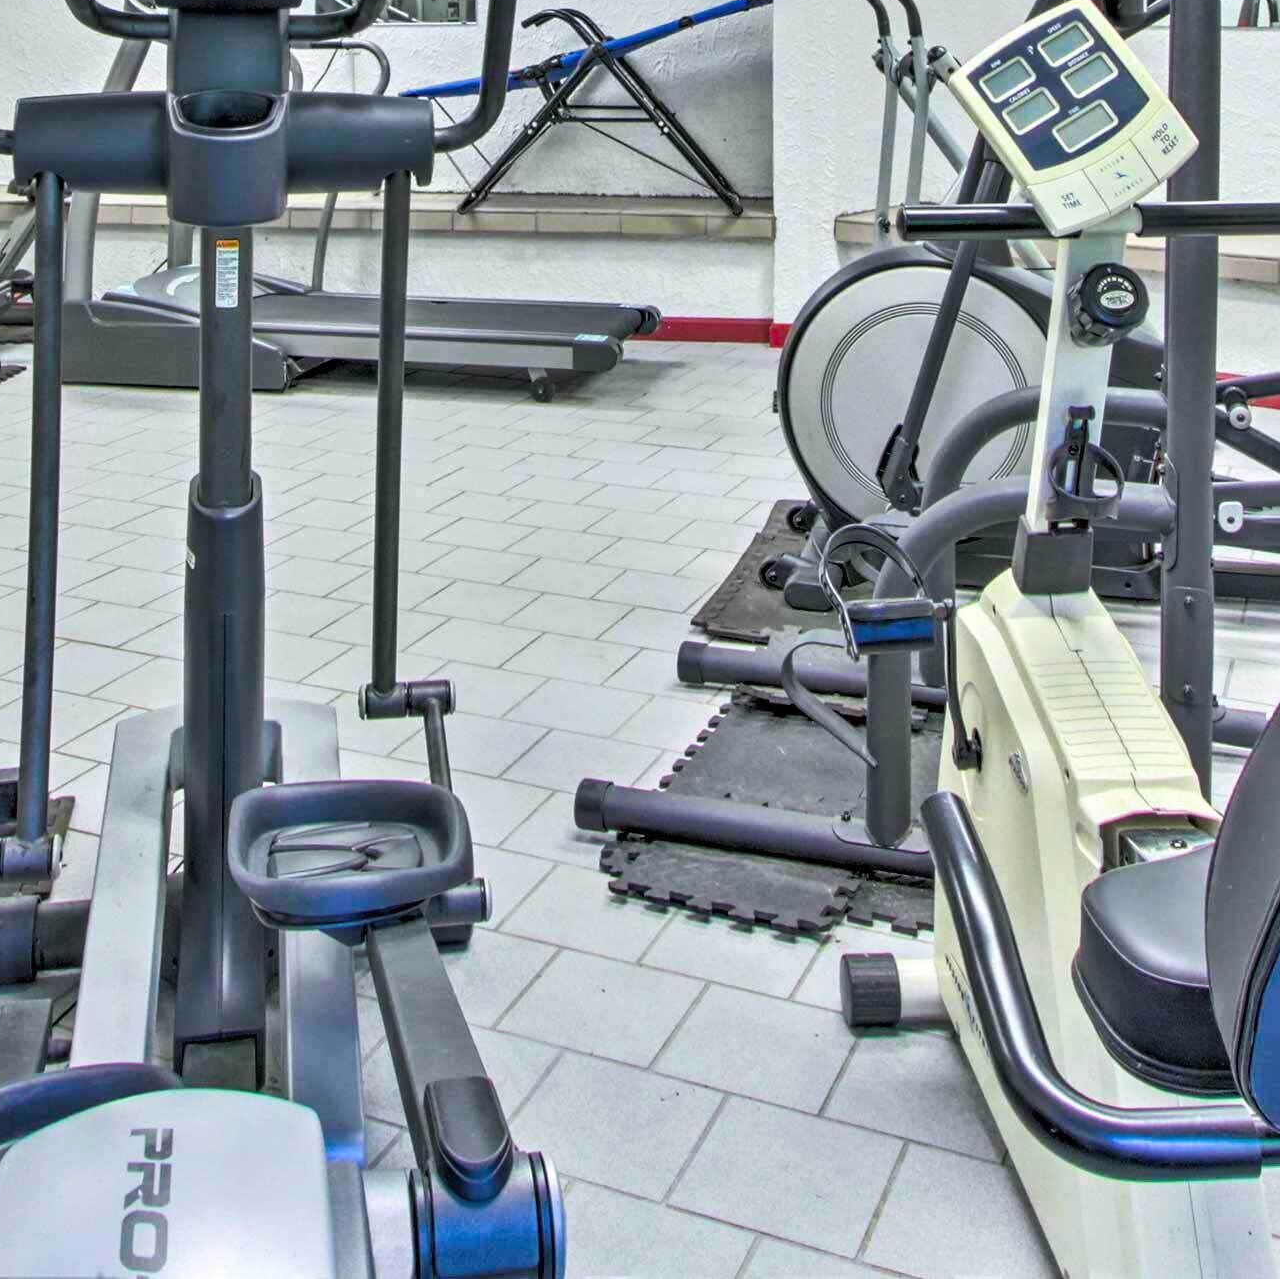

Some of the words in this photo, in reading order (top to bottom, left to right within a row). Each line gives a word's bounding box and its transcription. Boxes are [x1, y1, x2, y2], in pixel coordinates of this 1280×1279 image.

[1151, 122, 1169, 141] HOLD
[1160, 133, 1170, 144] TO
[1161, 135, 1180, 155] RESET
[1061, 192, 1075, 202] SET
[1061, 199, 1082, 210] TIME
